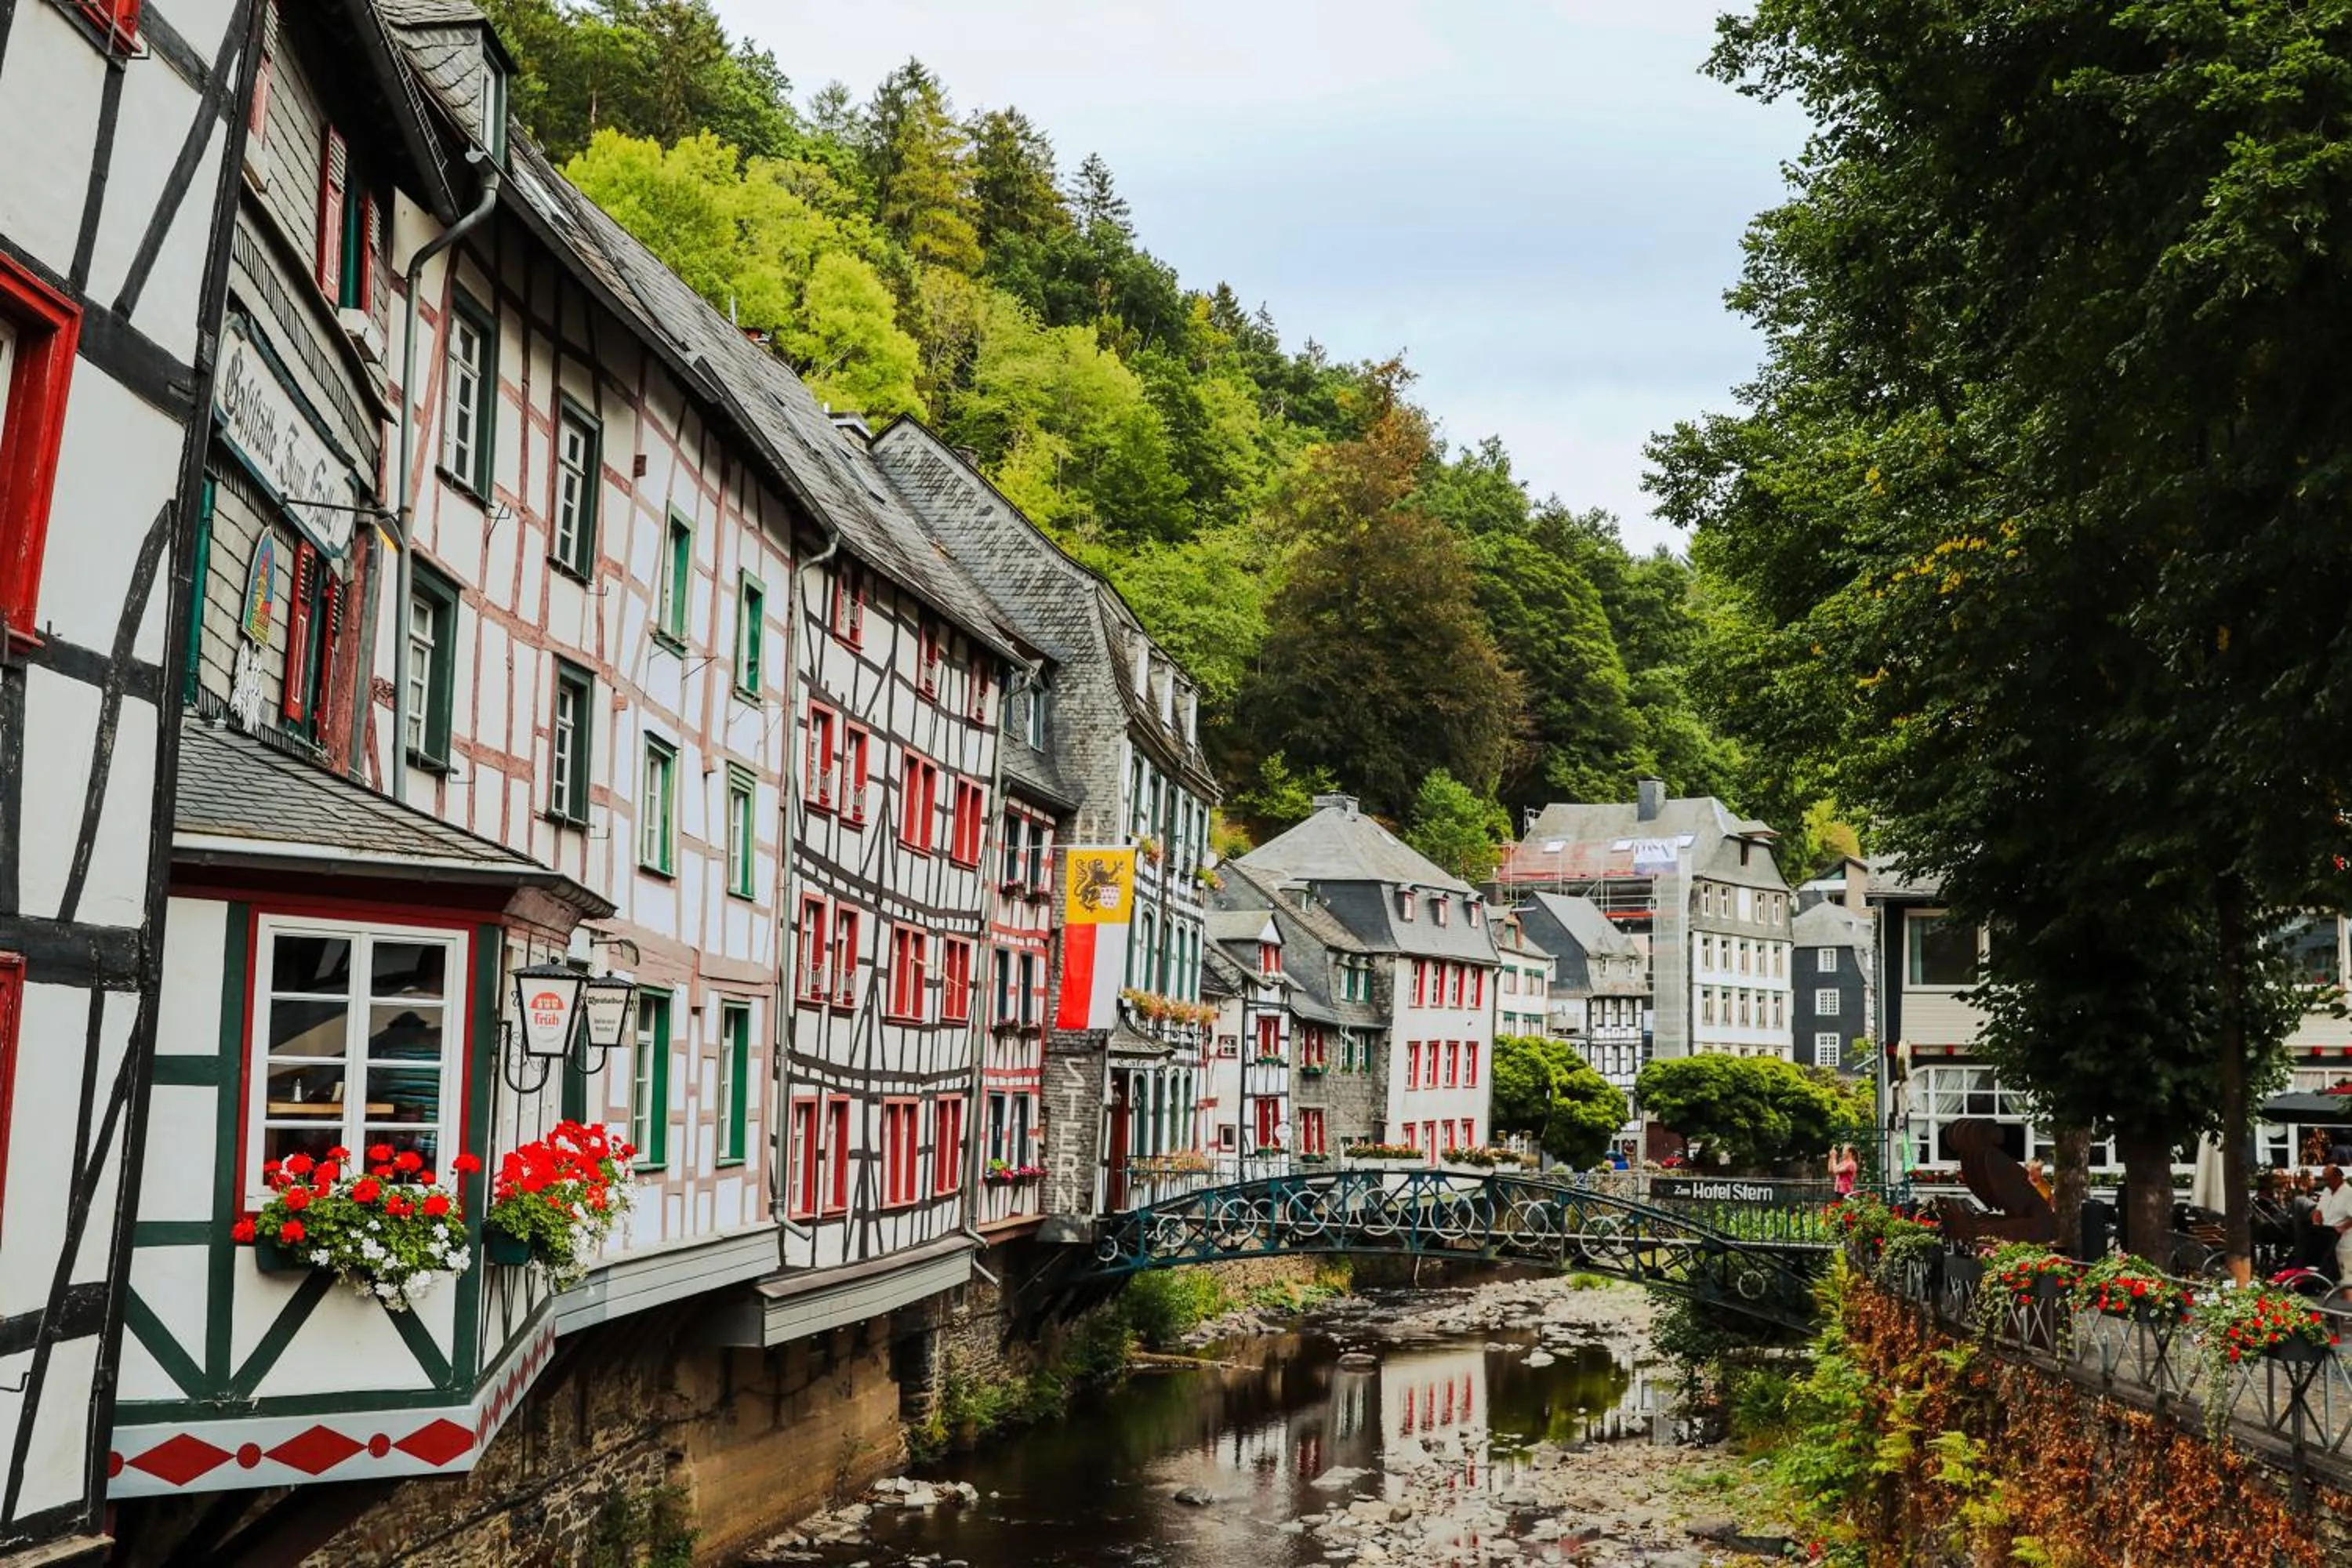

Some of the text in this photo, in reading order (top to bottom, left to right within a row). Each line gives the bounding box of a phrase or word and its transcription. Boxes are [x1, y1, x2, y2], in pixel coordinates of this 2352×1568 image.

[1054, 1058, 1091, 1214] STERN
[1693, 1181, 1730, 1200] Hotel
[1732, 1183, 1773, 1201] Stern
